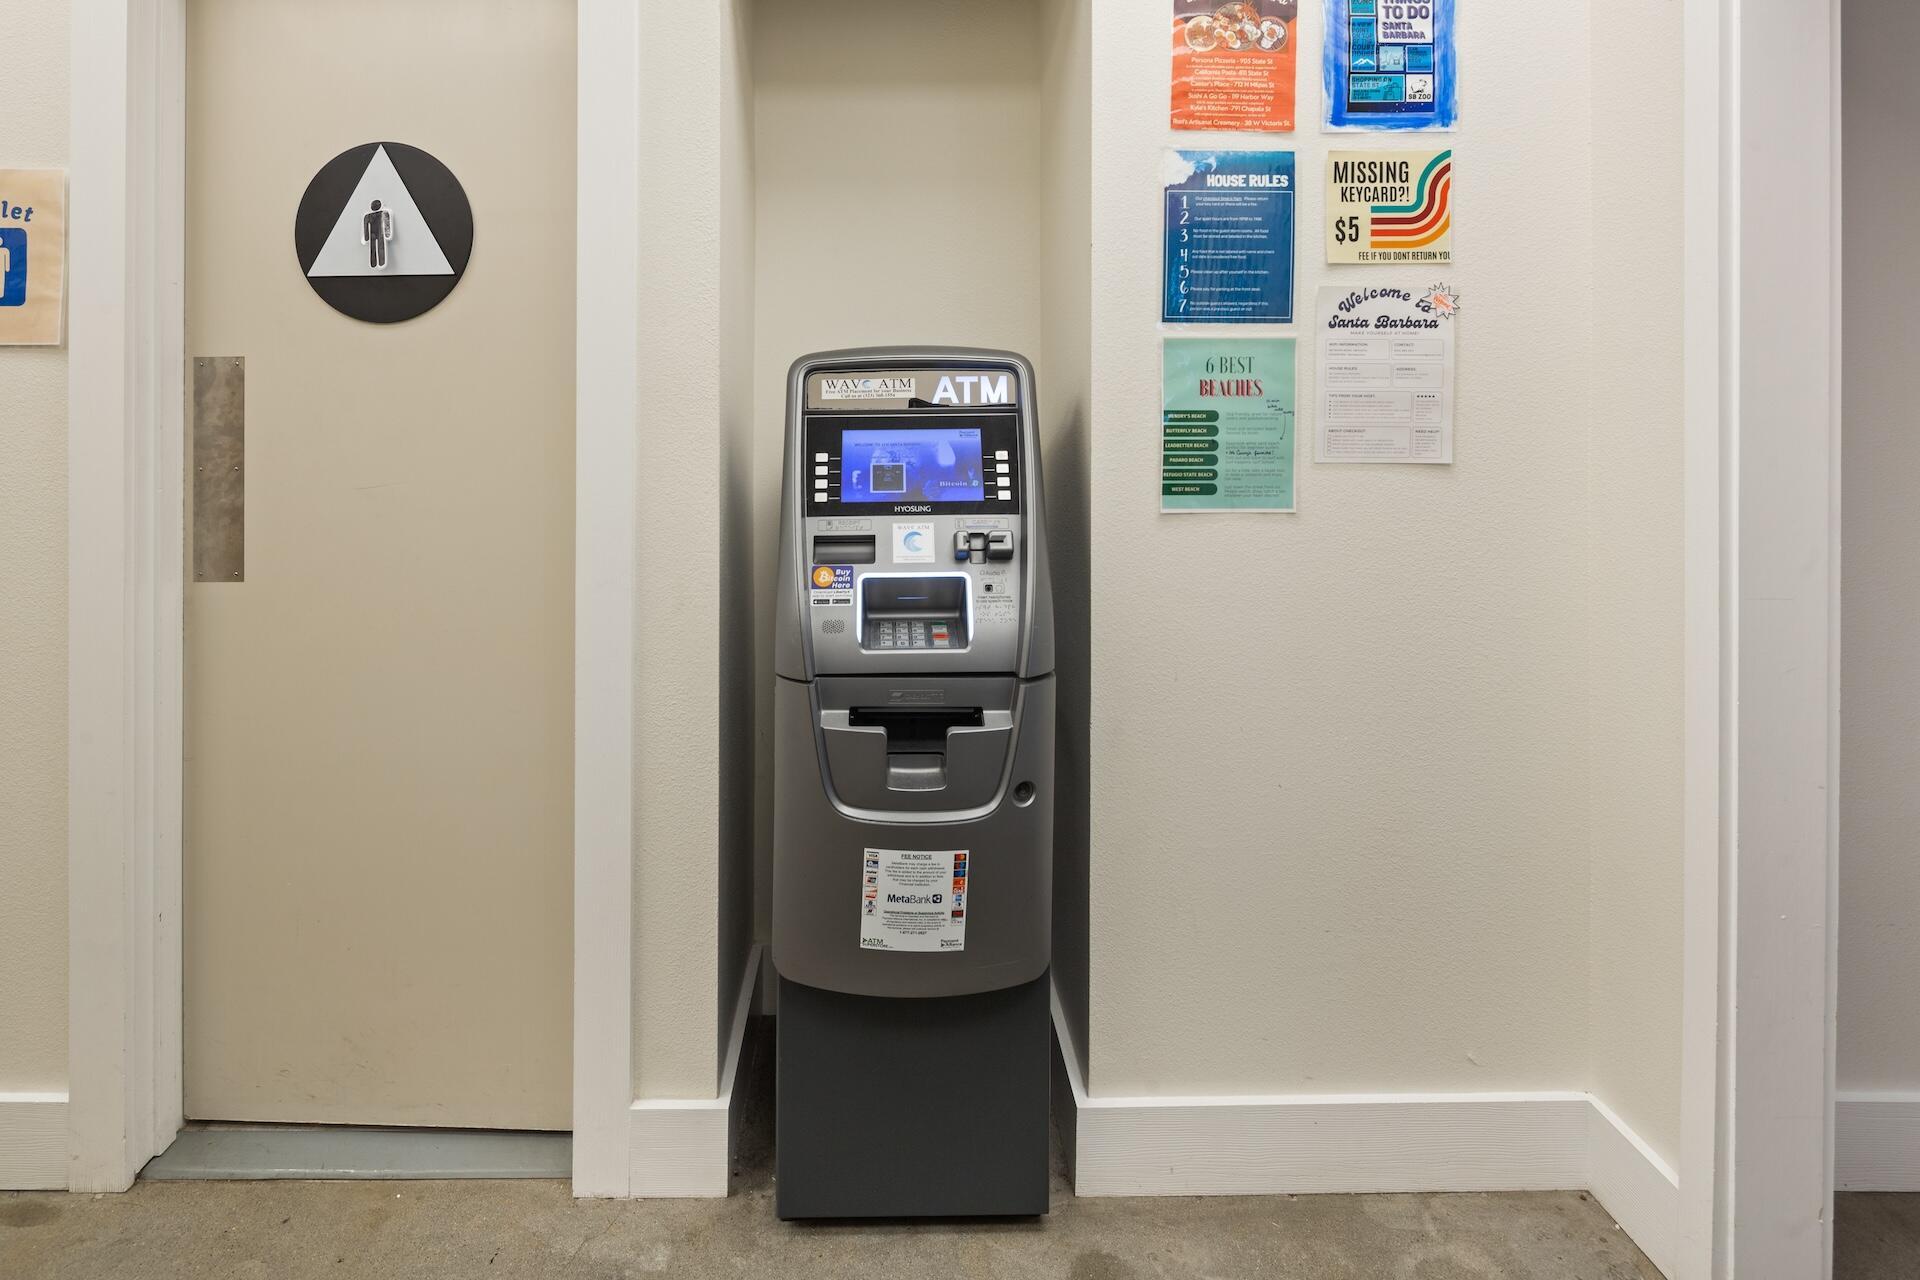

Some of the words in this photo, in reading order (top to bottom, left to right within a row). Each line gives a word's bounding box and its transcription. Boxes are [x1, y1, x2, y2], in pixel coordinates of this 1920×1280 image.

[1382, 6, 1404, 20] TO
[1408, 6, 1430, 20] DO
[1382, 22, 1413, 30] SANTA
[1382, 31, 1426, 39] BARBARA
[1333, 161, 1409, 183] MISSING
[1207, 174, 1247, 187] HOUSE
[1249, 174, 1289, 187] RULES
[1341, 186, 1410, 202] KEYCARD?!
[1180, 195, 1190, 209] 1
[2, 201, 33, 222] let
[1179, 211, 1190, 225] 2
[1180, 229, 1189, 242] 3
[1335, 216, 1359, 245] $5
[1180, 249, 1188, 262] 4
[1359, 251, 1369, 260] FEE
[1371, 251, 1377, 260] IF
[1379, 252, 1392, 260] YOU
[1393, 252, 1410, 260] DONT
[1412, 252, 1437, 260] RETURN
[1179, 265, 1190, 278] 5
[1179, 280, 1189, 294] 6
[1178, 299, 1187, 313] 7
[1339, 288, 1411, 312] Welcome
[1328, 315, 1370, 329] Santa
[1374, 315, 1439, 329] Barbara
[1206, 356, 1214, 374] 6
[1220, 356, 1256, 374] BEST
[879, 378, 911, 389] ATM
[932, 375, 1008, 404] ATM
[1199, 379, 1264, 398] BEACHES
[894, 505, 932, 513] HYOSUNG
[887, 894, 932, 904] MetaBank
